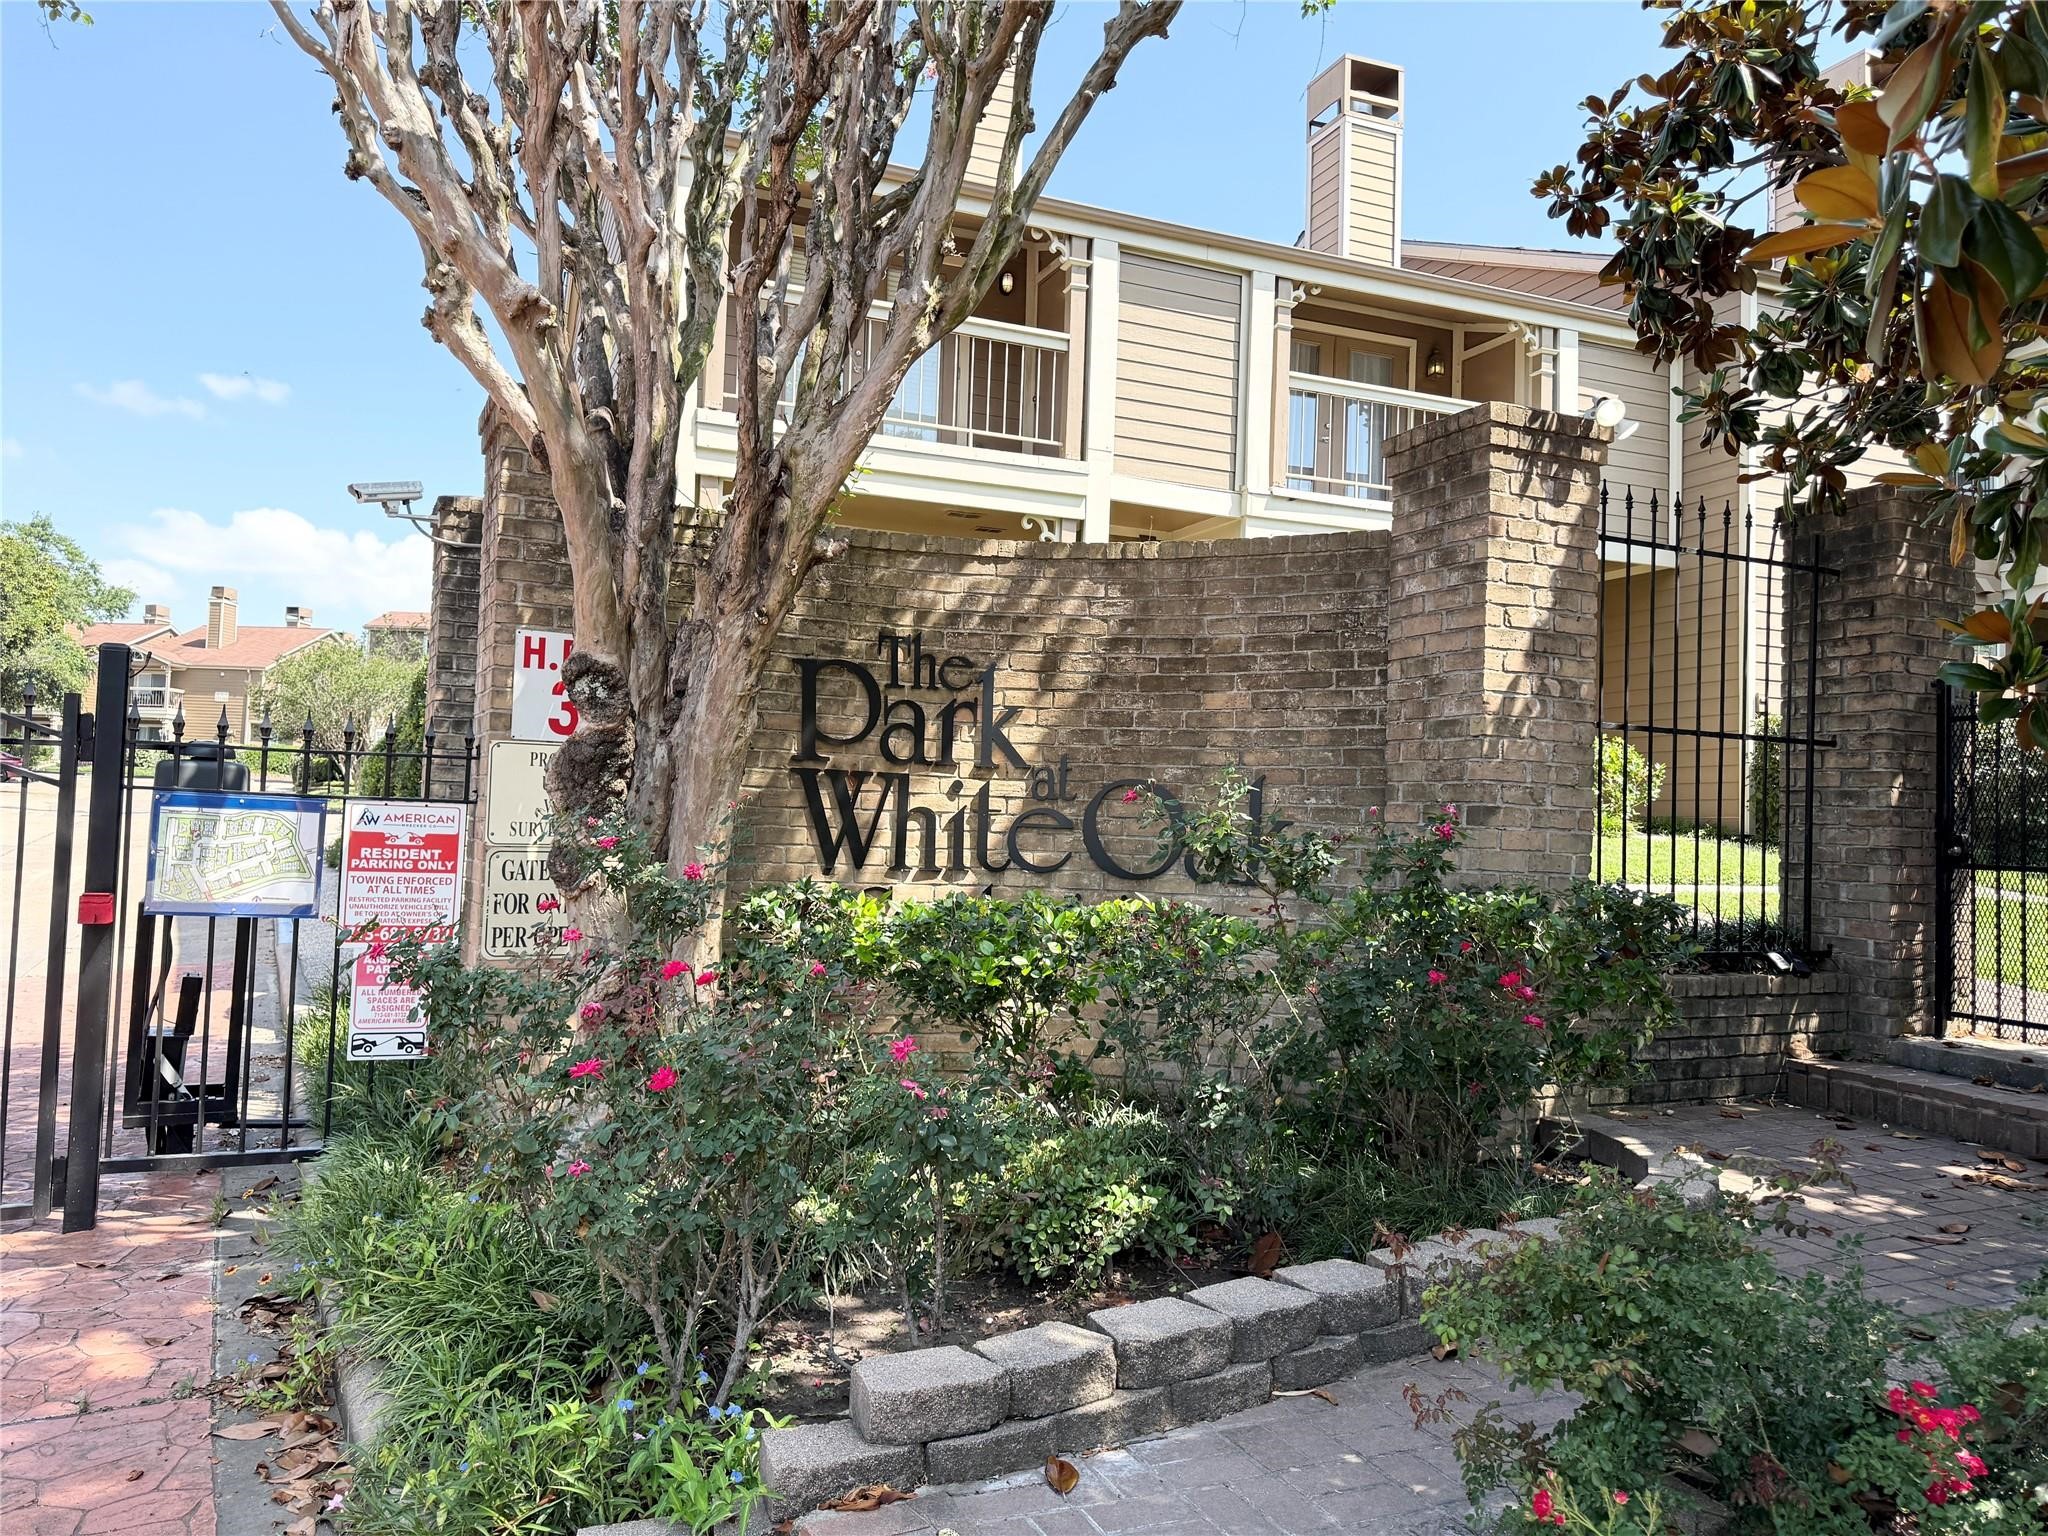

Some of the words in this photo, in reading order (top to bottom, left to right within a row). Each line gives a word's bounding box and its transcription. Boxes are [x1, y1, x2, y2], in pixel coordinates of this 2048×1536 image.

[877, 632, 975, 690] The
[788, 658, 1031, 769] Park
[1032, 754, 1078, 801] at
[383, 813, 455, 824] AMERICAN
[790, 767, 1074, 875] White
[360, 847, 442, 860] RESIDENT
[350, 859, 414, 869] PARKING
[417, 860, 455, 871] ONLY
[350, 875, 394, 885] TOWING
[397, 876, 453, 886] ENFORCED
[367, 885, 380, 894] AT
[382, 885, 402, 894] ALL
[404, 885, 436, 895] TIMES
[493, 893, 529, 914] FOR
[491, 926, 529, 948] PER
[361, 988, 376, 996] ALL
[370, 1004, 411, 1012] ASSIGNED
